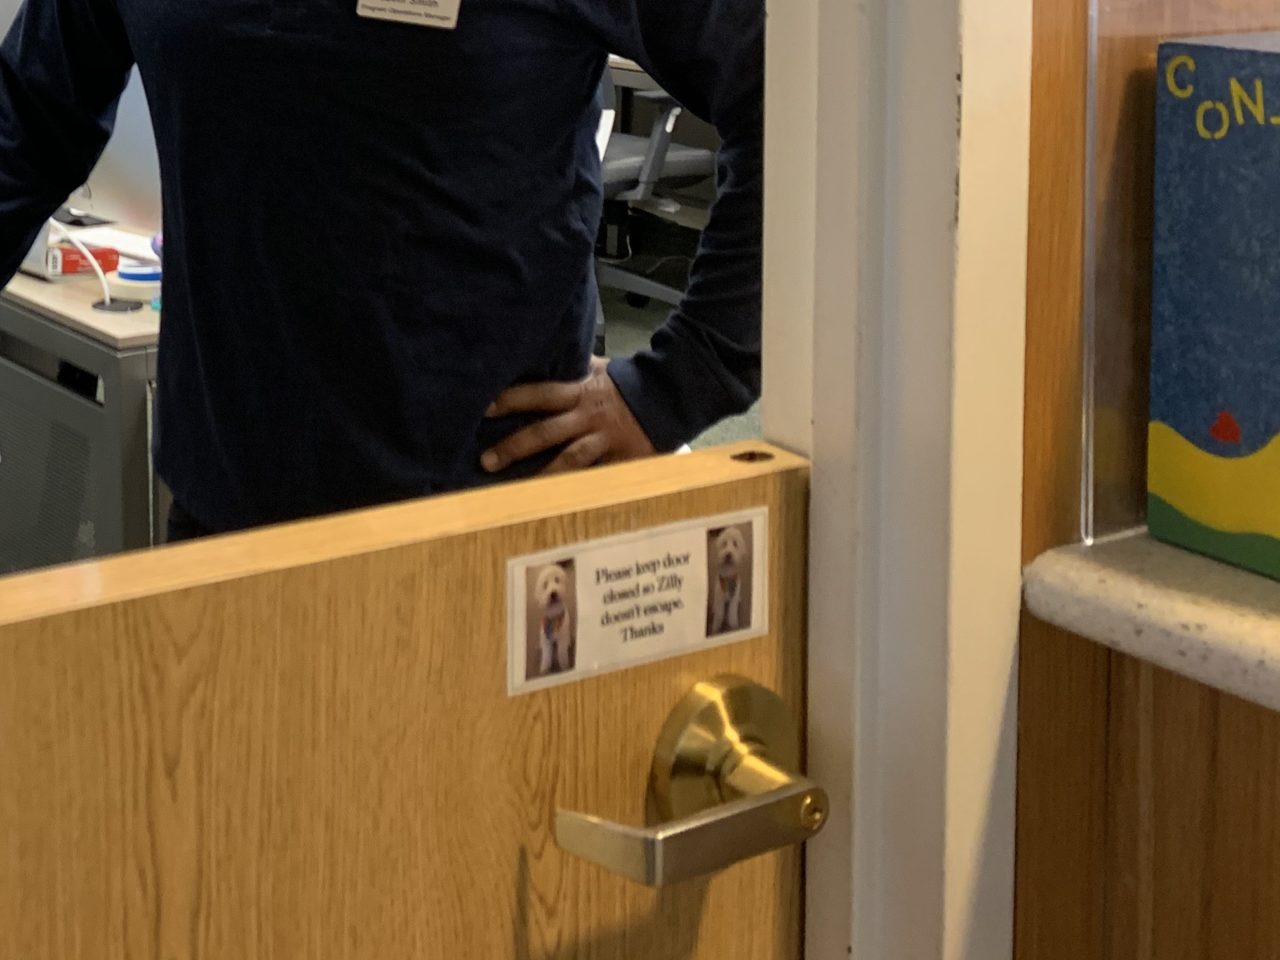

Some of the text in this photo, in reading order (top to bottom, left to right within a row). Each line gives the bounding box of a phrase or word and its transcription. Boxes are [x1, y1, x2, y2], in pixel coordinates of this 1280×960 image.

[1165, 53, 1280, 140] CON
[594, 551, 691, 586] Please keep door
[602, 582, 640, 605] closed
[641, 583, 656, 595] so
[620, 620, 665, 643] Thanks
